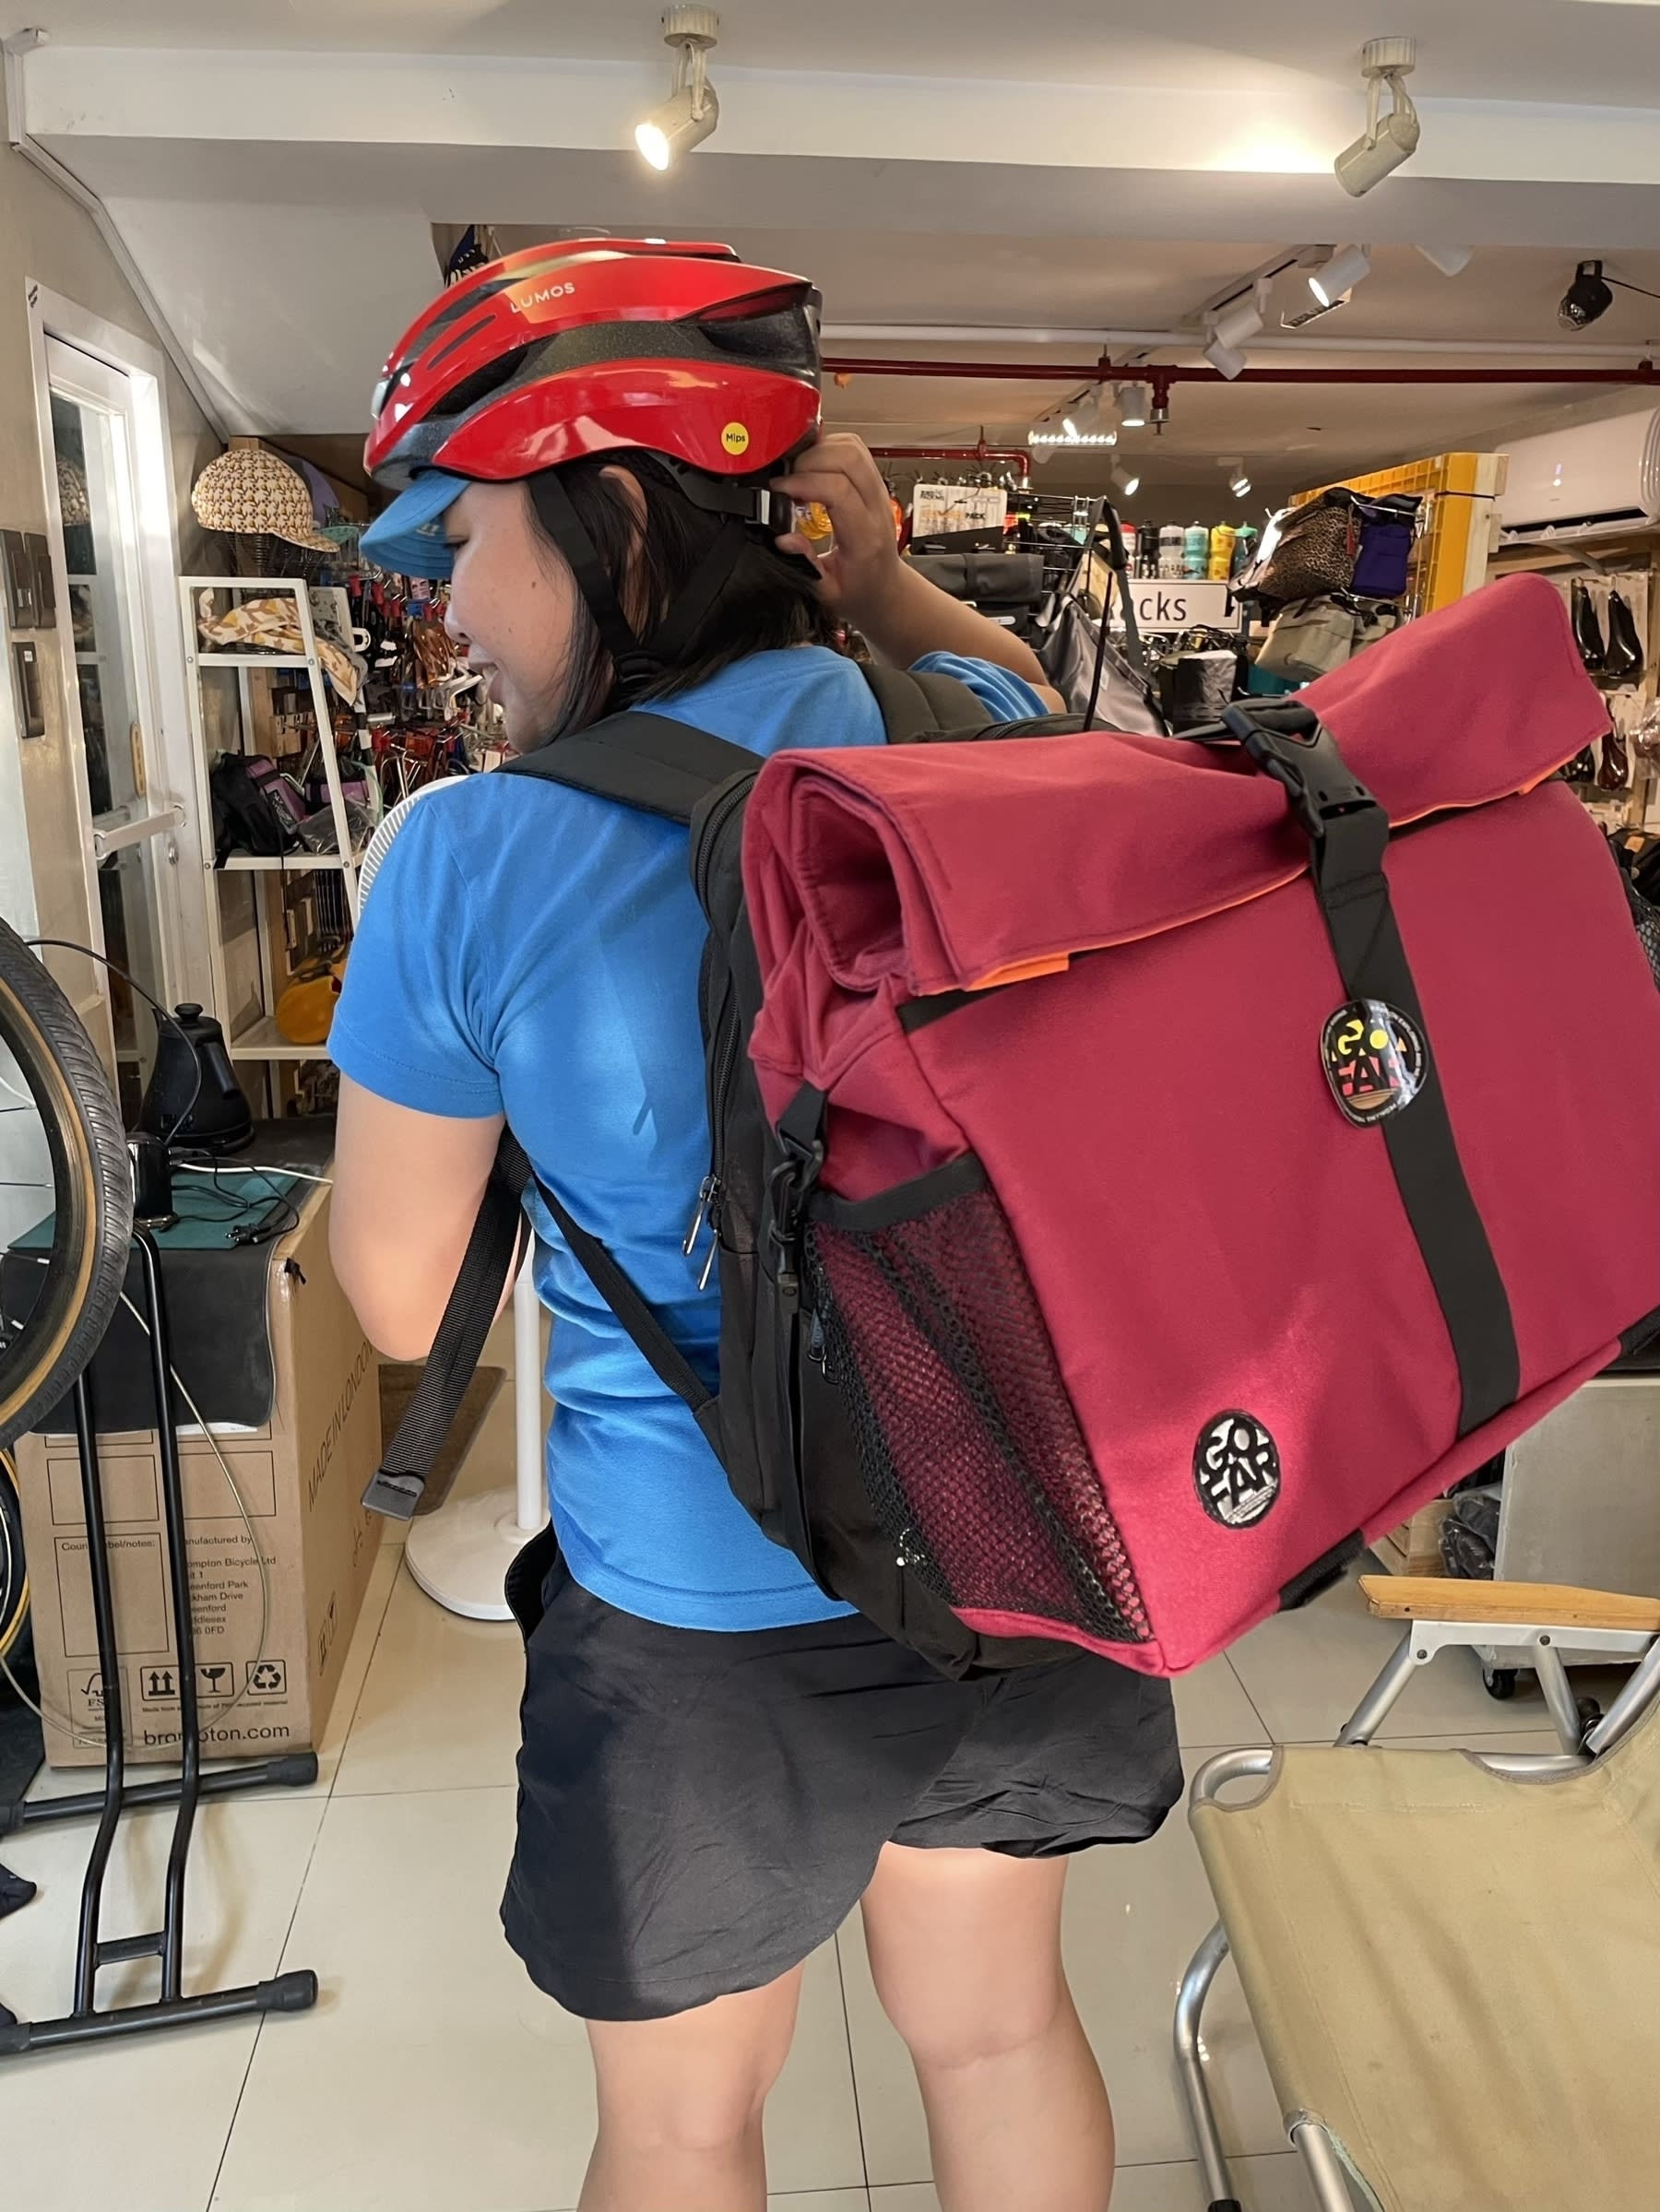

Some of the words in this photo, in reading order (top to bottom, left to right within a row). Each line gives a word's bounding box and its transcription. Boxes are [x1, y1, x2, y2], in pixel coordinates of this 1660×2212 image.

[510, 282, 575, 313] LUMOS
[726, 432, 746, 444] Mips
[1140, 591, 1187, 621] cks
[308, 1425, 332, 1512] MADE
[61, 1542, 89, 1551] Coun
[107, 1539, 156, 1549] bel/notes:
[185, 1536, 238, 1544] anufactured
[187, 1559, 222, 1567] ompton
[224, 1557, 258, 1567] Bicycle
[190, 1581, 225, 1590] eenford
[219, 1592, 243, 1601] Drive
[144, 1725, 290, 1746] bropton.com
